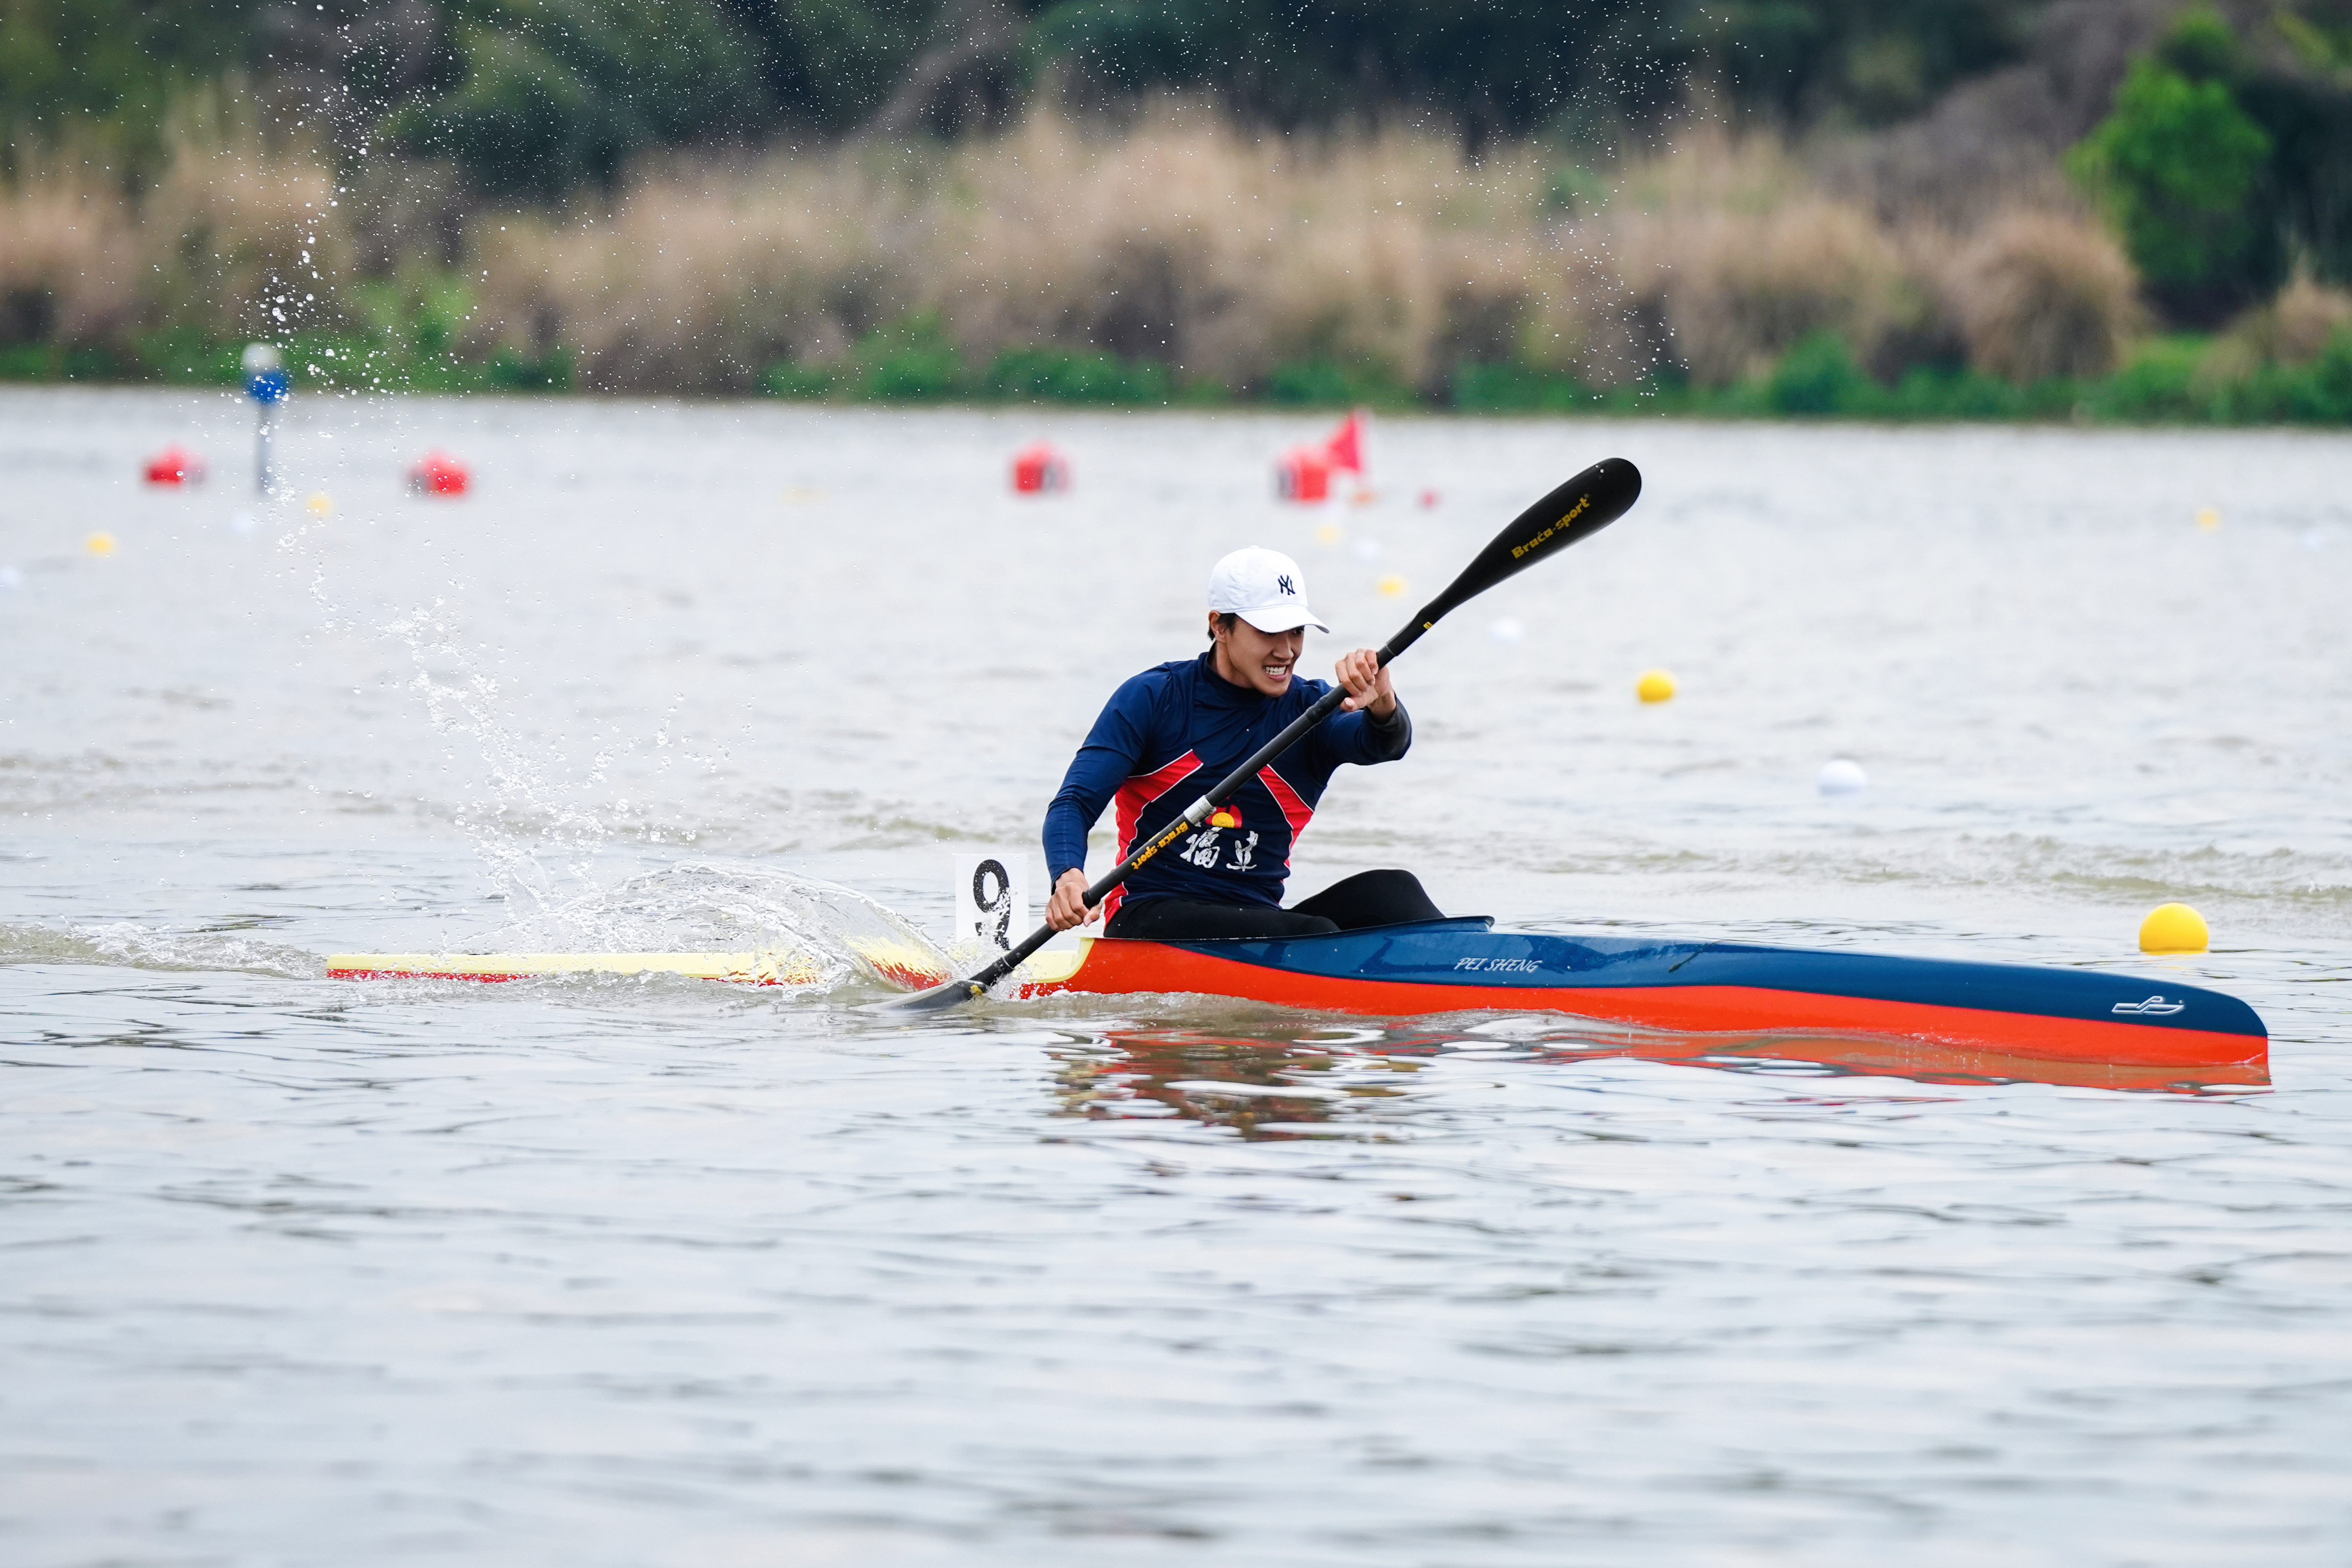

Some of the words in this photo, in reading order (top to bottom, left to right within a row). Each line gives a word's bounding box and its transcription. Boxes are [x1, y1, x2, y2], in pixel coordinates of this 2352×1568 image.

[1278, 574, 1295, 595] NY
[973, 859, 1011, 950] 9
[1454, 957, 1488, 970] PEI
[1484, 958, 1542, 973] SHENG
